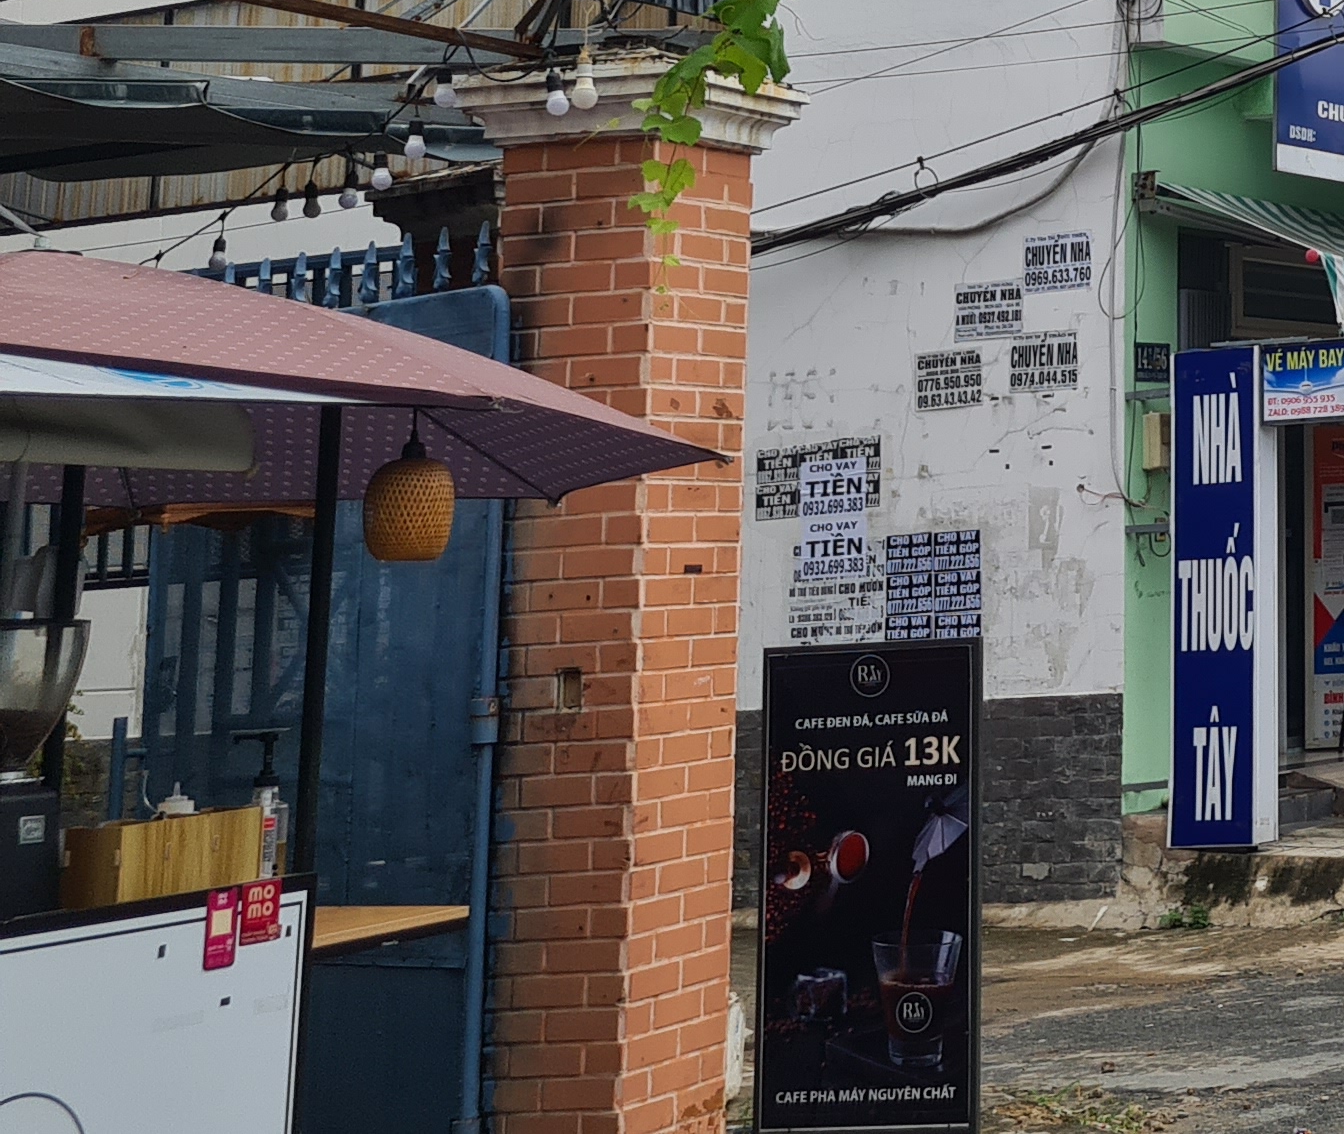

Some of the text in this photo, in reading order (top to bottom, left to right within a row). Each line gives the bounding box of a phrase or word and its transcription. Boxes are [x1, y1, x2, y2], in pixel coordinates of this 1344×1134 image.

[1070, 237, 1091, 263] NHÀ
[1025, 265, 1092, 287] 0969.633.760
[1265, 346, 1344, 372] VÉ MÁY BAY
[1010, 368, 1078, 387] 0974.044.515
[1191, 372, 1242, 486] NHÀ
[809, 461, 858, 473] CHO VAY
[805, 472, 862, 499] TIỀN
[802, 496, 863, 517] 0932.699.383
[809, 520, 858, 533] CHO VAY
[806, 532, 863, 558] TIỀN
[803, 557, 864, 577] 0932.699.383
[1178, 522, 1255, 652] THUỐC
[795, 709, 949, 729] CAFE ĐEN ĐÁ, CAFE SỮA ĐÁ
[781, 735, 961, 772] ĐỒNG GIÁ 13K
[1193, 705, 1238, 822] TÂY
[906, 773, 957, 787] MANG ĐI
[248, 884, 275, 903] mo
[247, 901, 274, 919] mo
[775, 1082, 957, 1103] CAFE PHA MÁY NGUYÊN CHẤT
